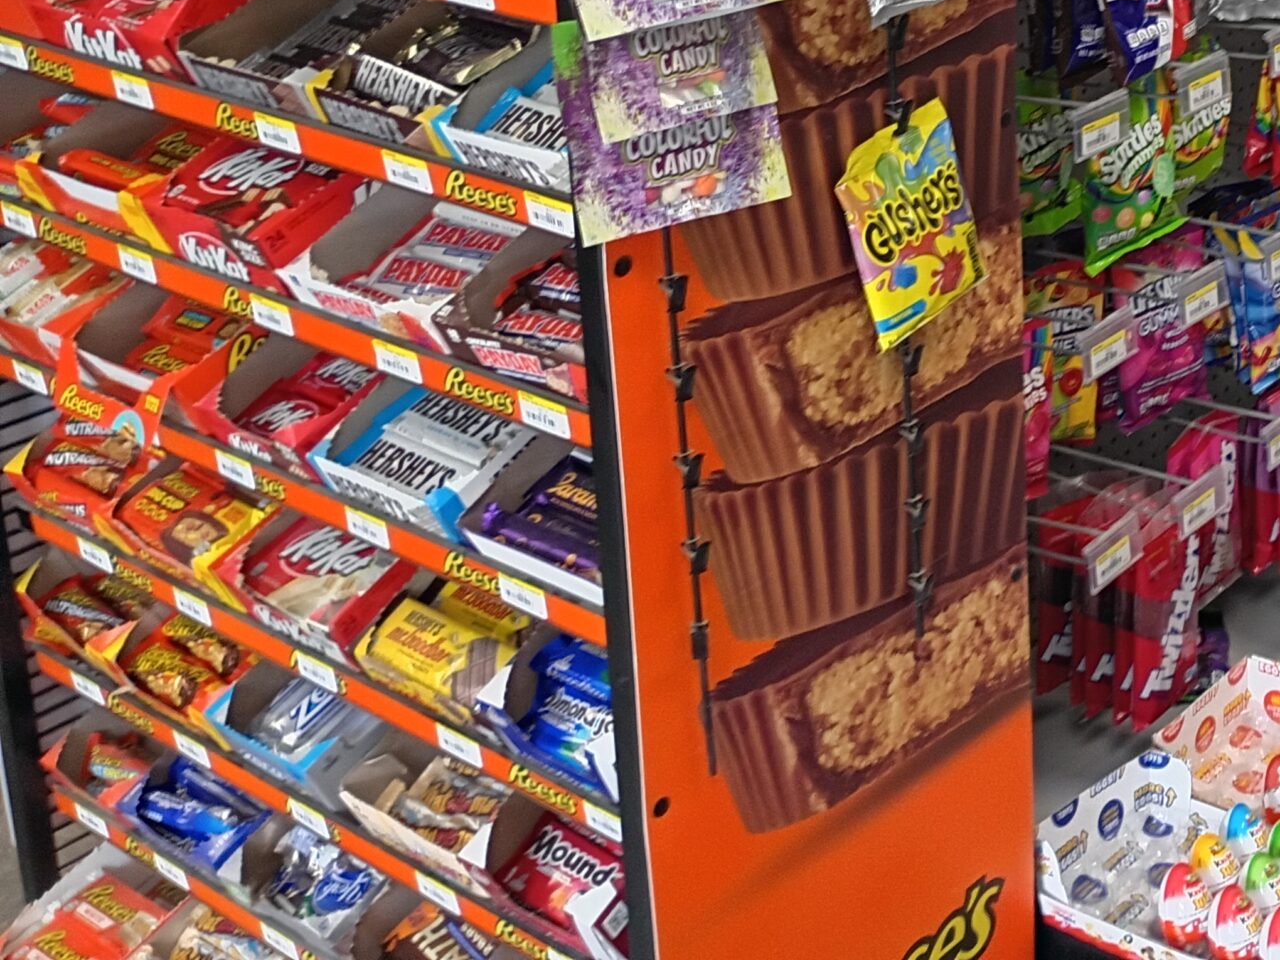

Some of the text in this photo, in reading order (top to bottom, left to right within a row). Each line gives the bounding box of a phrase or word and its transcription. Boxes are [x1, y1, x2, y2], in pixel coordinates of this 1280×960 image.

[633, 18, 729, 59] COLORFUL
[658, 43, 723, 78] CANDY
[26, 47, 75, 83] Reese's
[353, 55, 443, 112] HERSHEY'S
[624, 117, 734, 164] COLORFUL
[1170, 97, 1232, 150] Skittles
[649, 144, 721, 181] CANDY
[1100, 113, 1163, 186] Skittles
[445, 170, 516, 217] Reese's
[864, 165, 962, 260] Gushers
[39, 217, 87, 255] Reese's
[181, 235, 251, 283] KitKat
[474, 345, 544, 374] PAYDAY
[60, 384, 104, 420] Reese's
[445, 366, 516, 416] Reese's
[411, 393, 512, 441] HERSHEY'S
[355, 438, 457, 496] HERSHEY'S
[509, 764, 578, 816] Reese's
